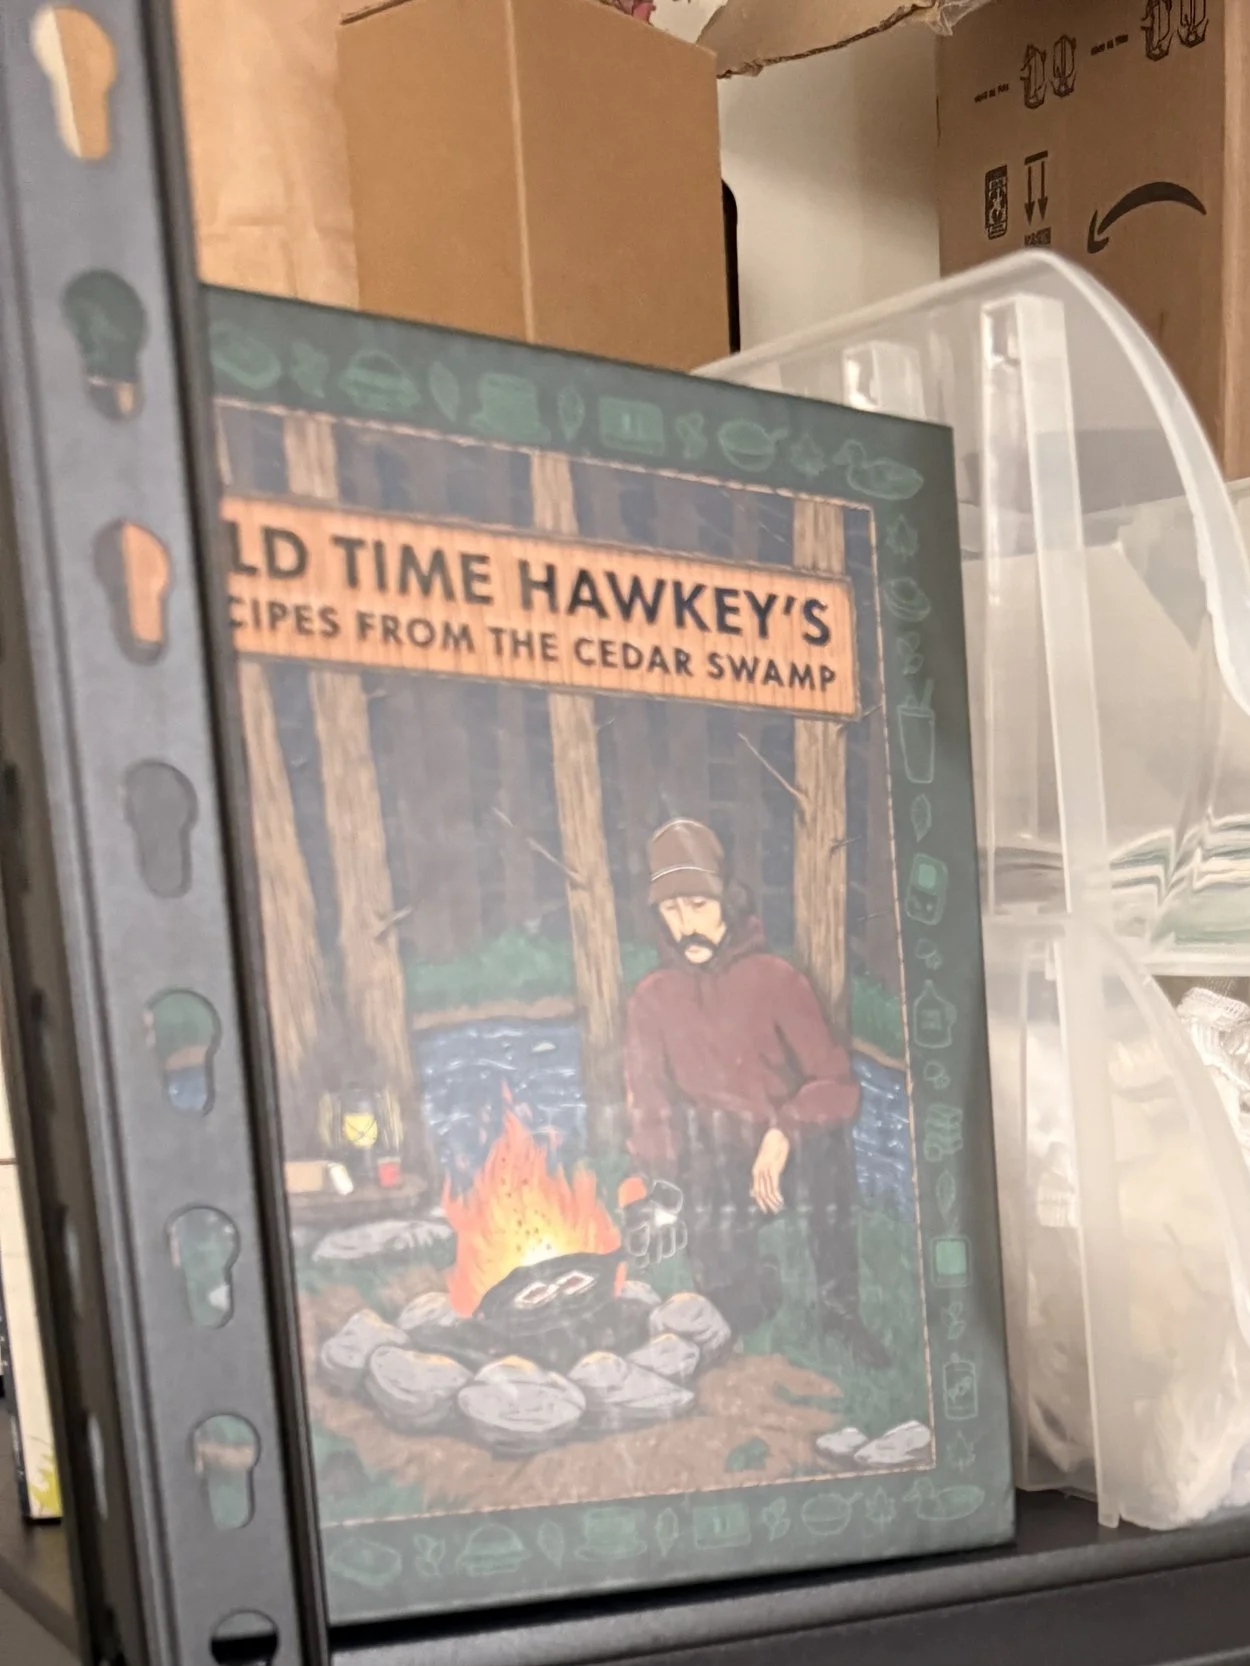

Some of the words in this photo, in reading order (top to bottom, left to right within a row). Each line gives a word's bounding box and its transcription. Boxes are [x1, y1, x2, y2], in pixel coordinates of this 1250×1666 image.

[228, 520, 309, 581] LD
[330, 534, 493, 605] TIME
[518, 557, 832, 647] HAWKEY'S
[228, 596, 340, 639] CIPES
[355, 609, 475, 653] FROM
[487, 626, 559, 663] THE
[573, 636, 691, 680] CEDAR
[707, 652, 837, 693] SWAMP
